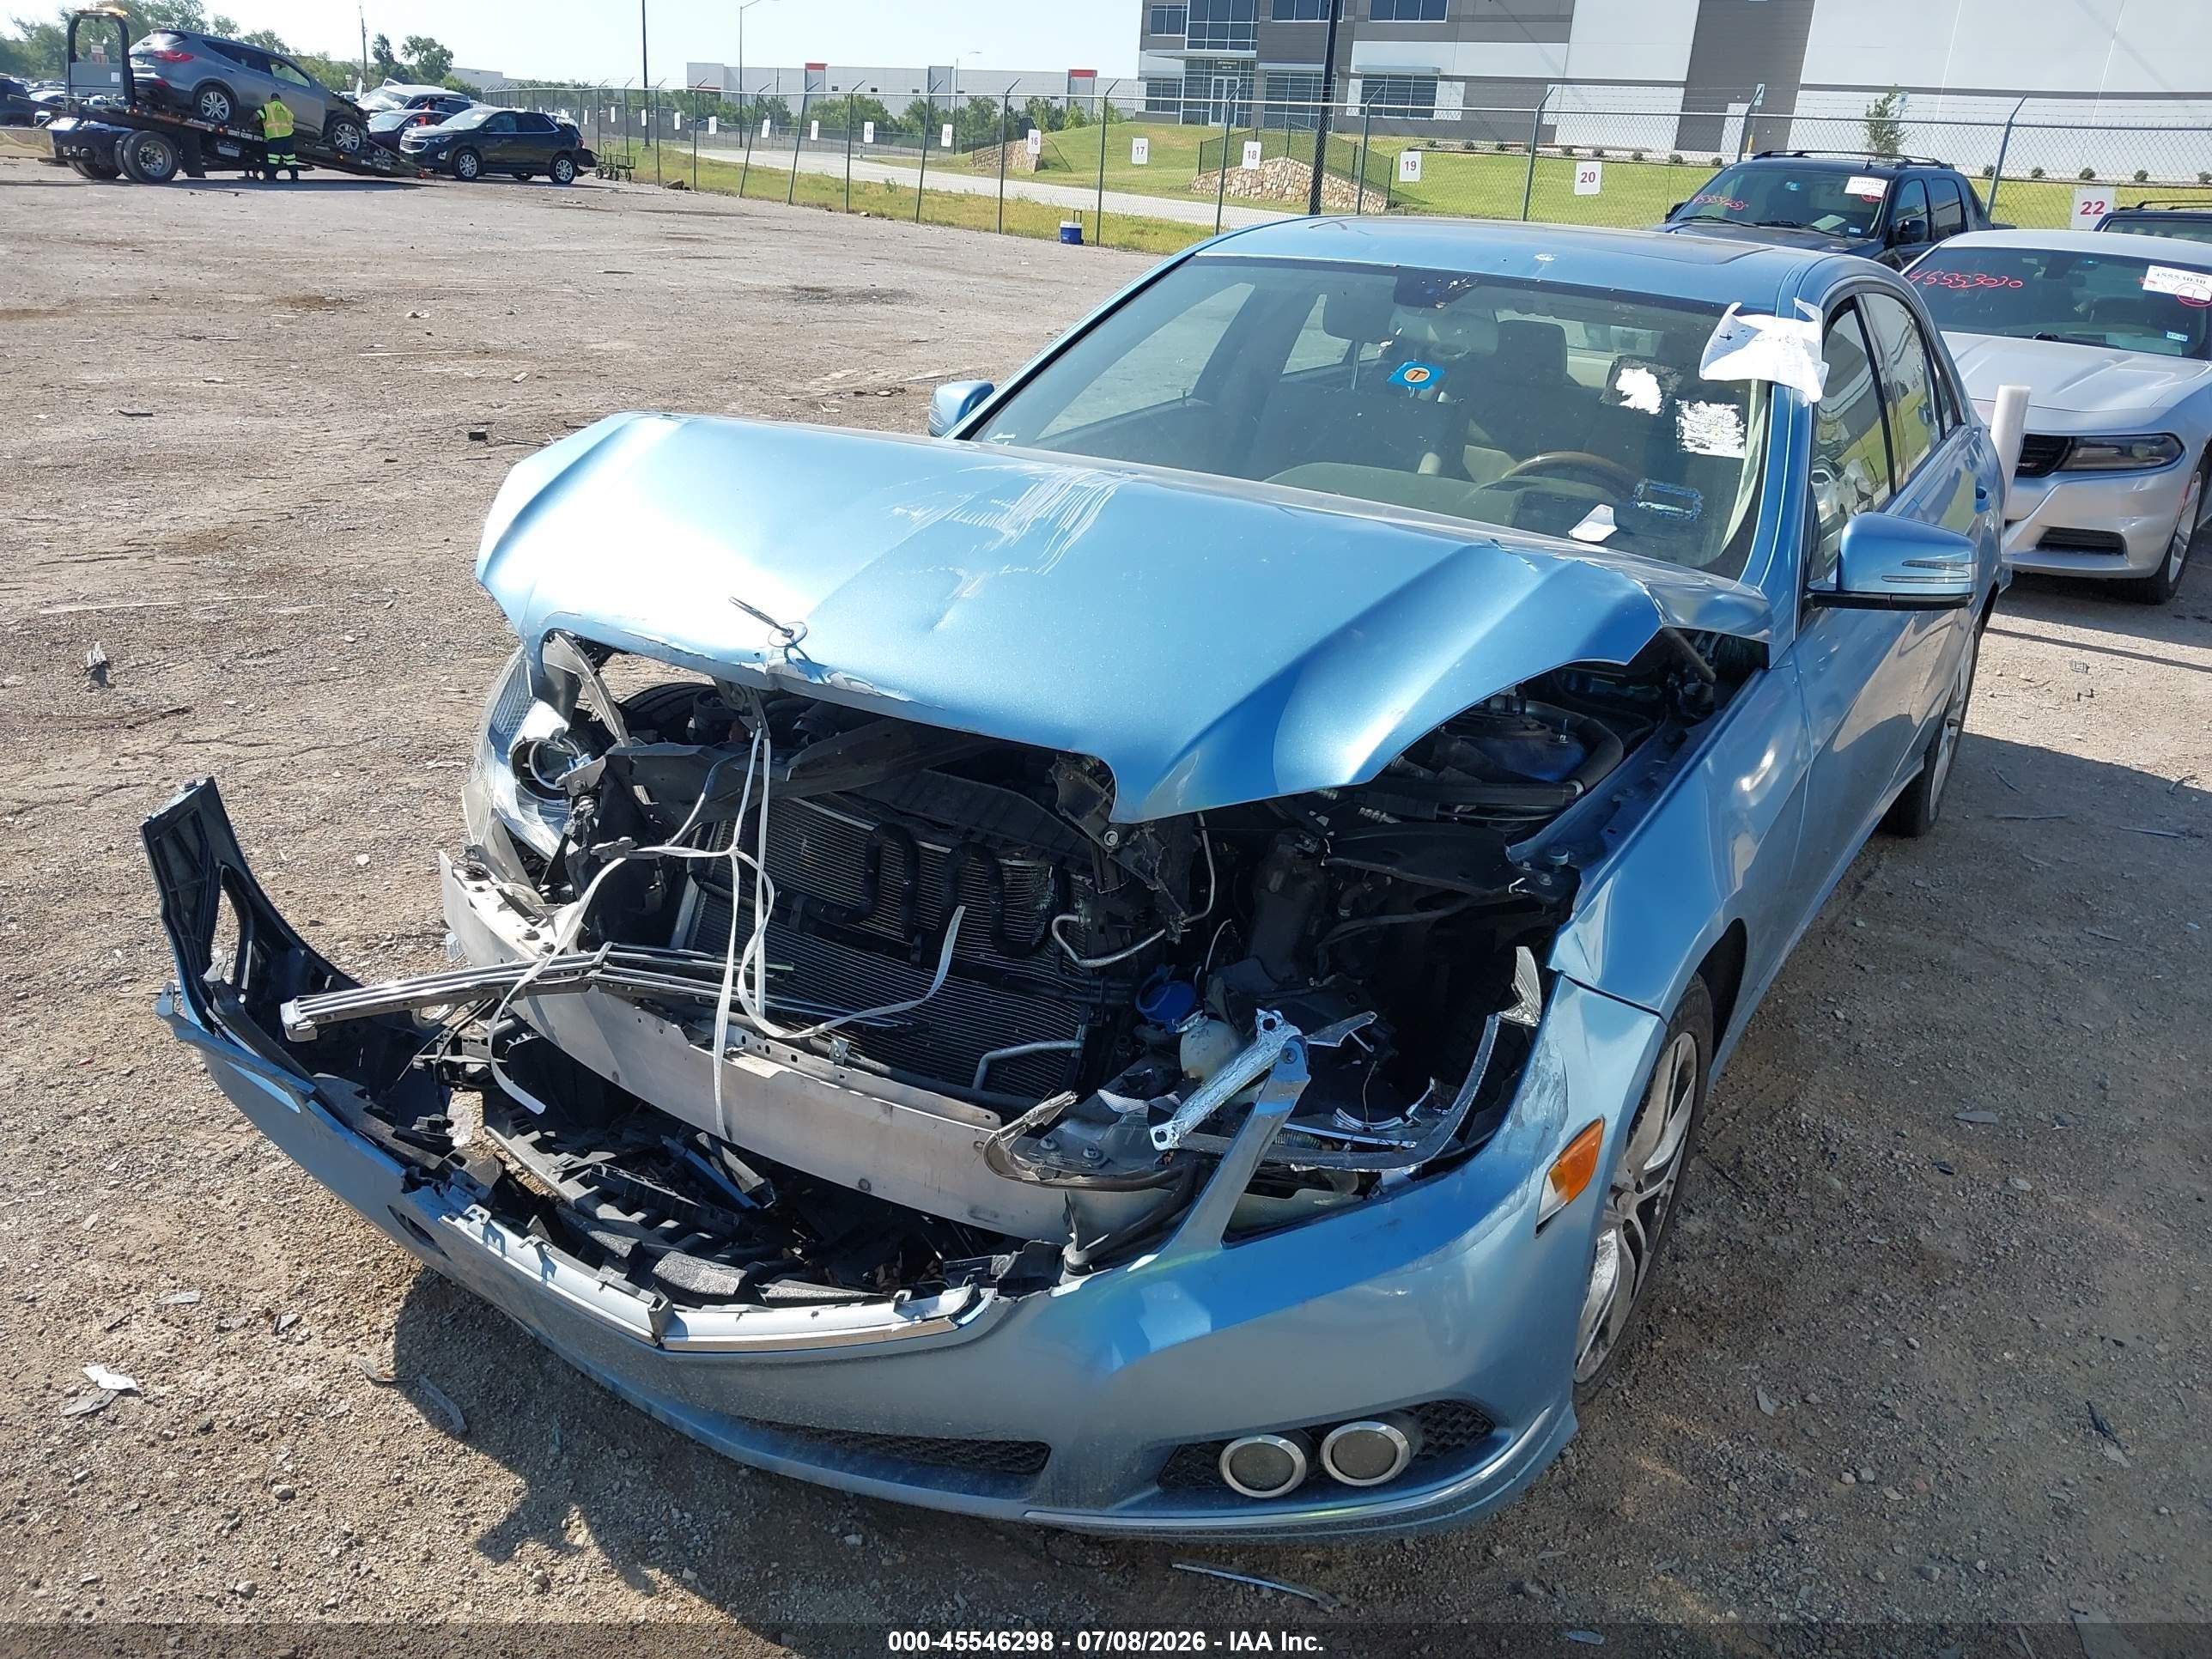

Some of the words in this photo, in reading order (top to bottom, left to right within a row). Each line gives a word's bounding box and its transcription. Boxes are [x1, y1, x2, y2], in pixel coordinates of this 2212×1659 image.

[1030, 137, 1038, 146] 16
[1135, 146, 1146, 155] 17
[1247, 150, 1257, 160] 18
[1404, 161, 1417, 172] 19
[1579, 171, 1596, 184] 20
[2080, 200, 2106, 216] 22
[1908, 267, 2024, 289] 45553030
